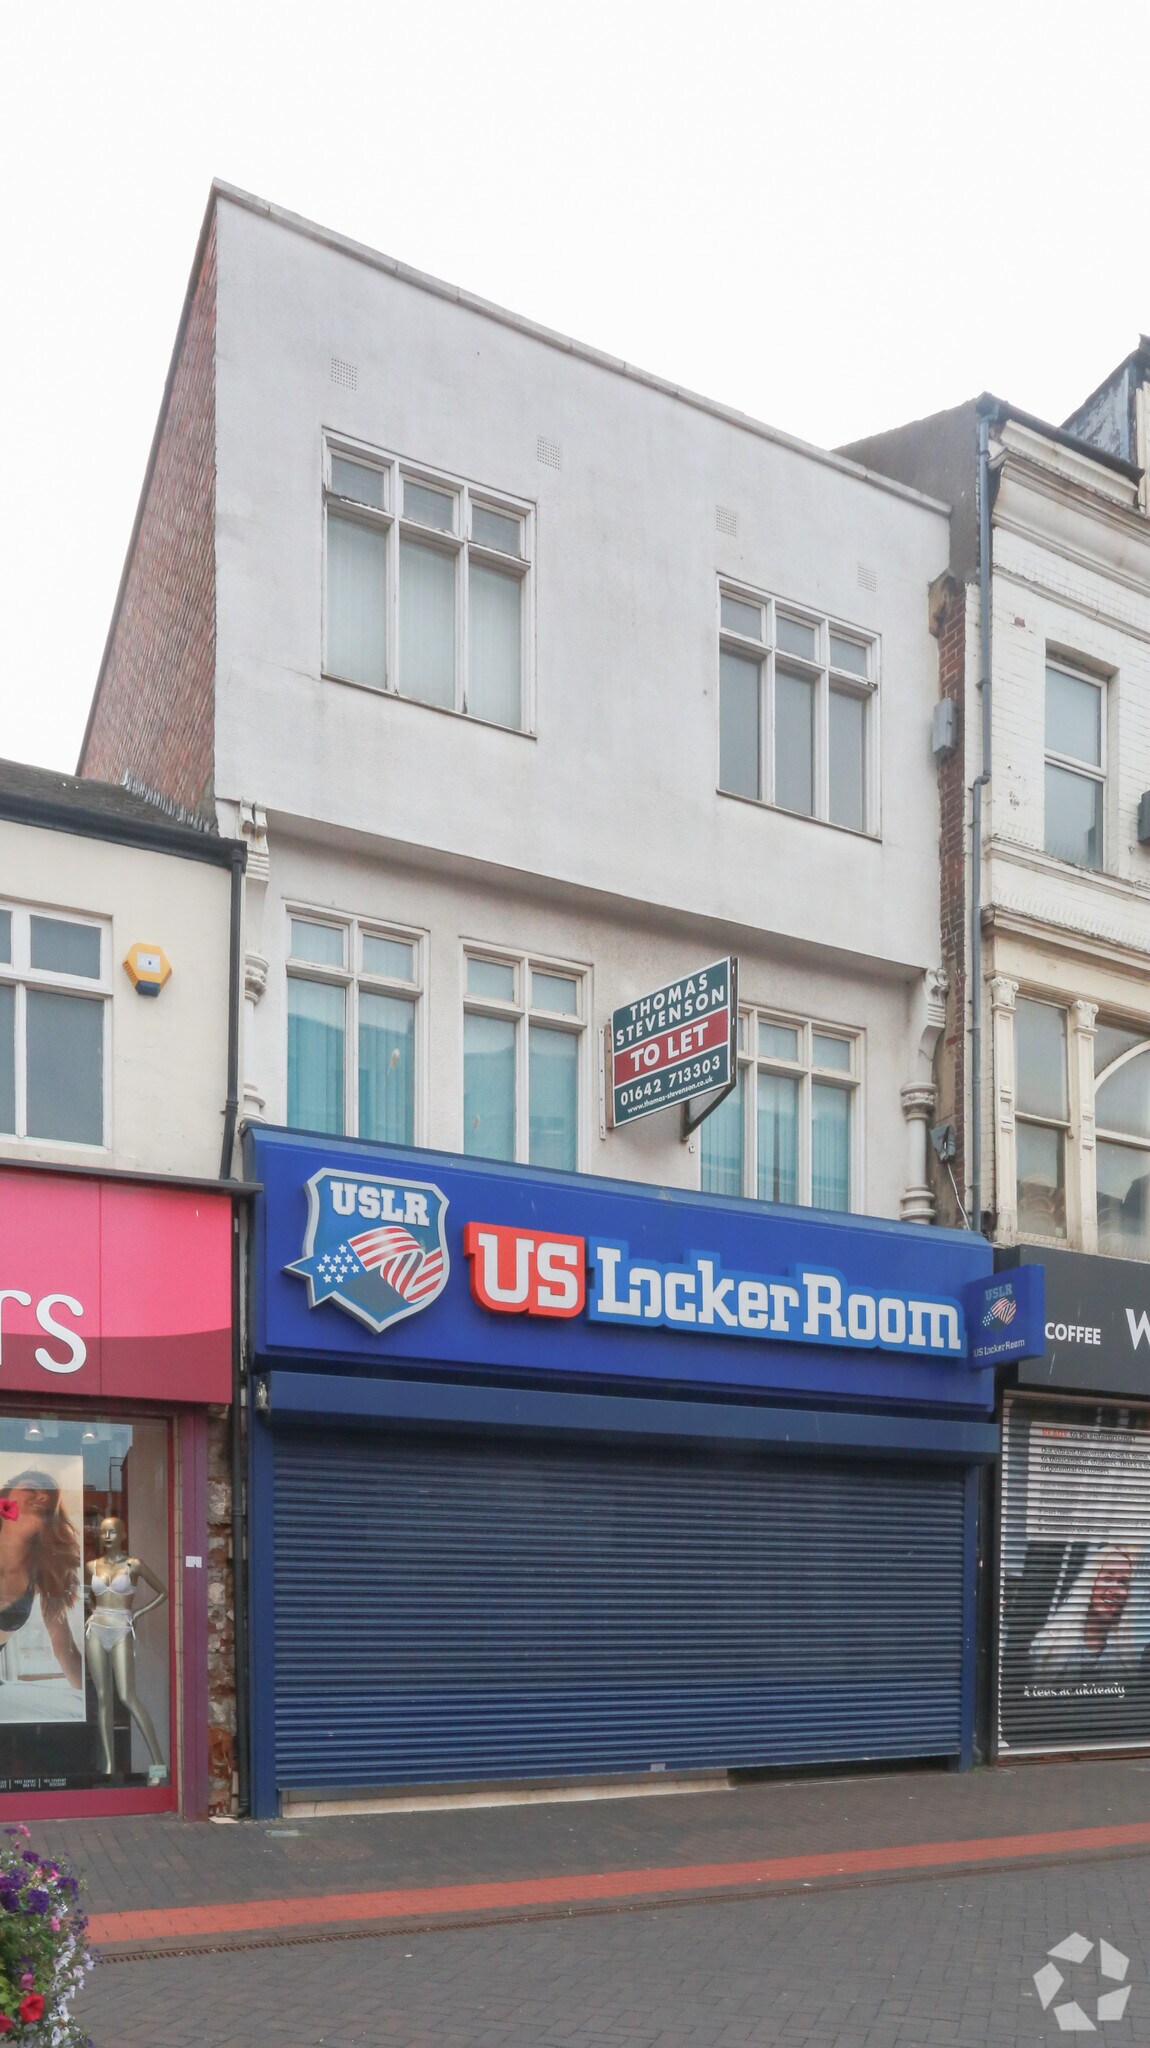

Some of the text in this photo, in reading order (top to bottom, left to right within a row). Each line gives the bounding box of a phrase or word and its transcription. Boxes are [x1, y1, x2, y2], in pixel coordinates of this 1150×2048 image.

[616, 985, 724, 1046] STEVENSON
[630, 973, 708, 1021] THOMAS
[630, 1022, 709, 1072] TO LET
[620, 1055, 721, 1106] 01642 713303
[627, 1075, 714, 1114] www.thomas-stevenson.co.uk
[330, 1181, 430, 1227] USLR
[478, 1233, 579, 1310] US
[985, 1283, 1013, 1301] USLR
[973, 1347, 984, 1358] US
[1044, 1322, 1102, 1345] COFFEE
